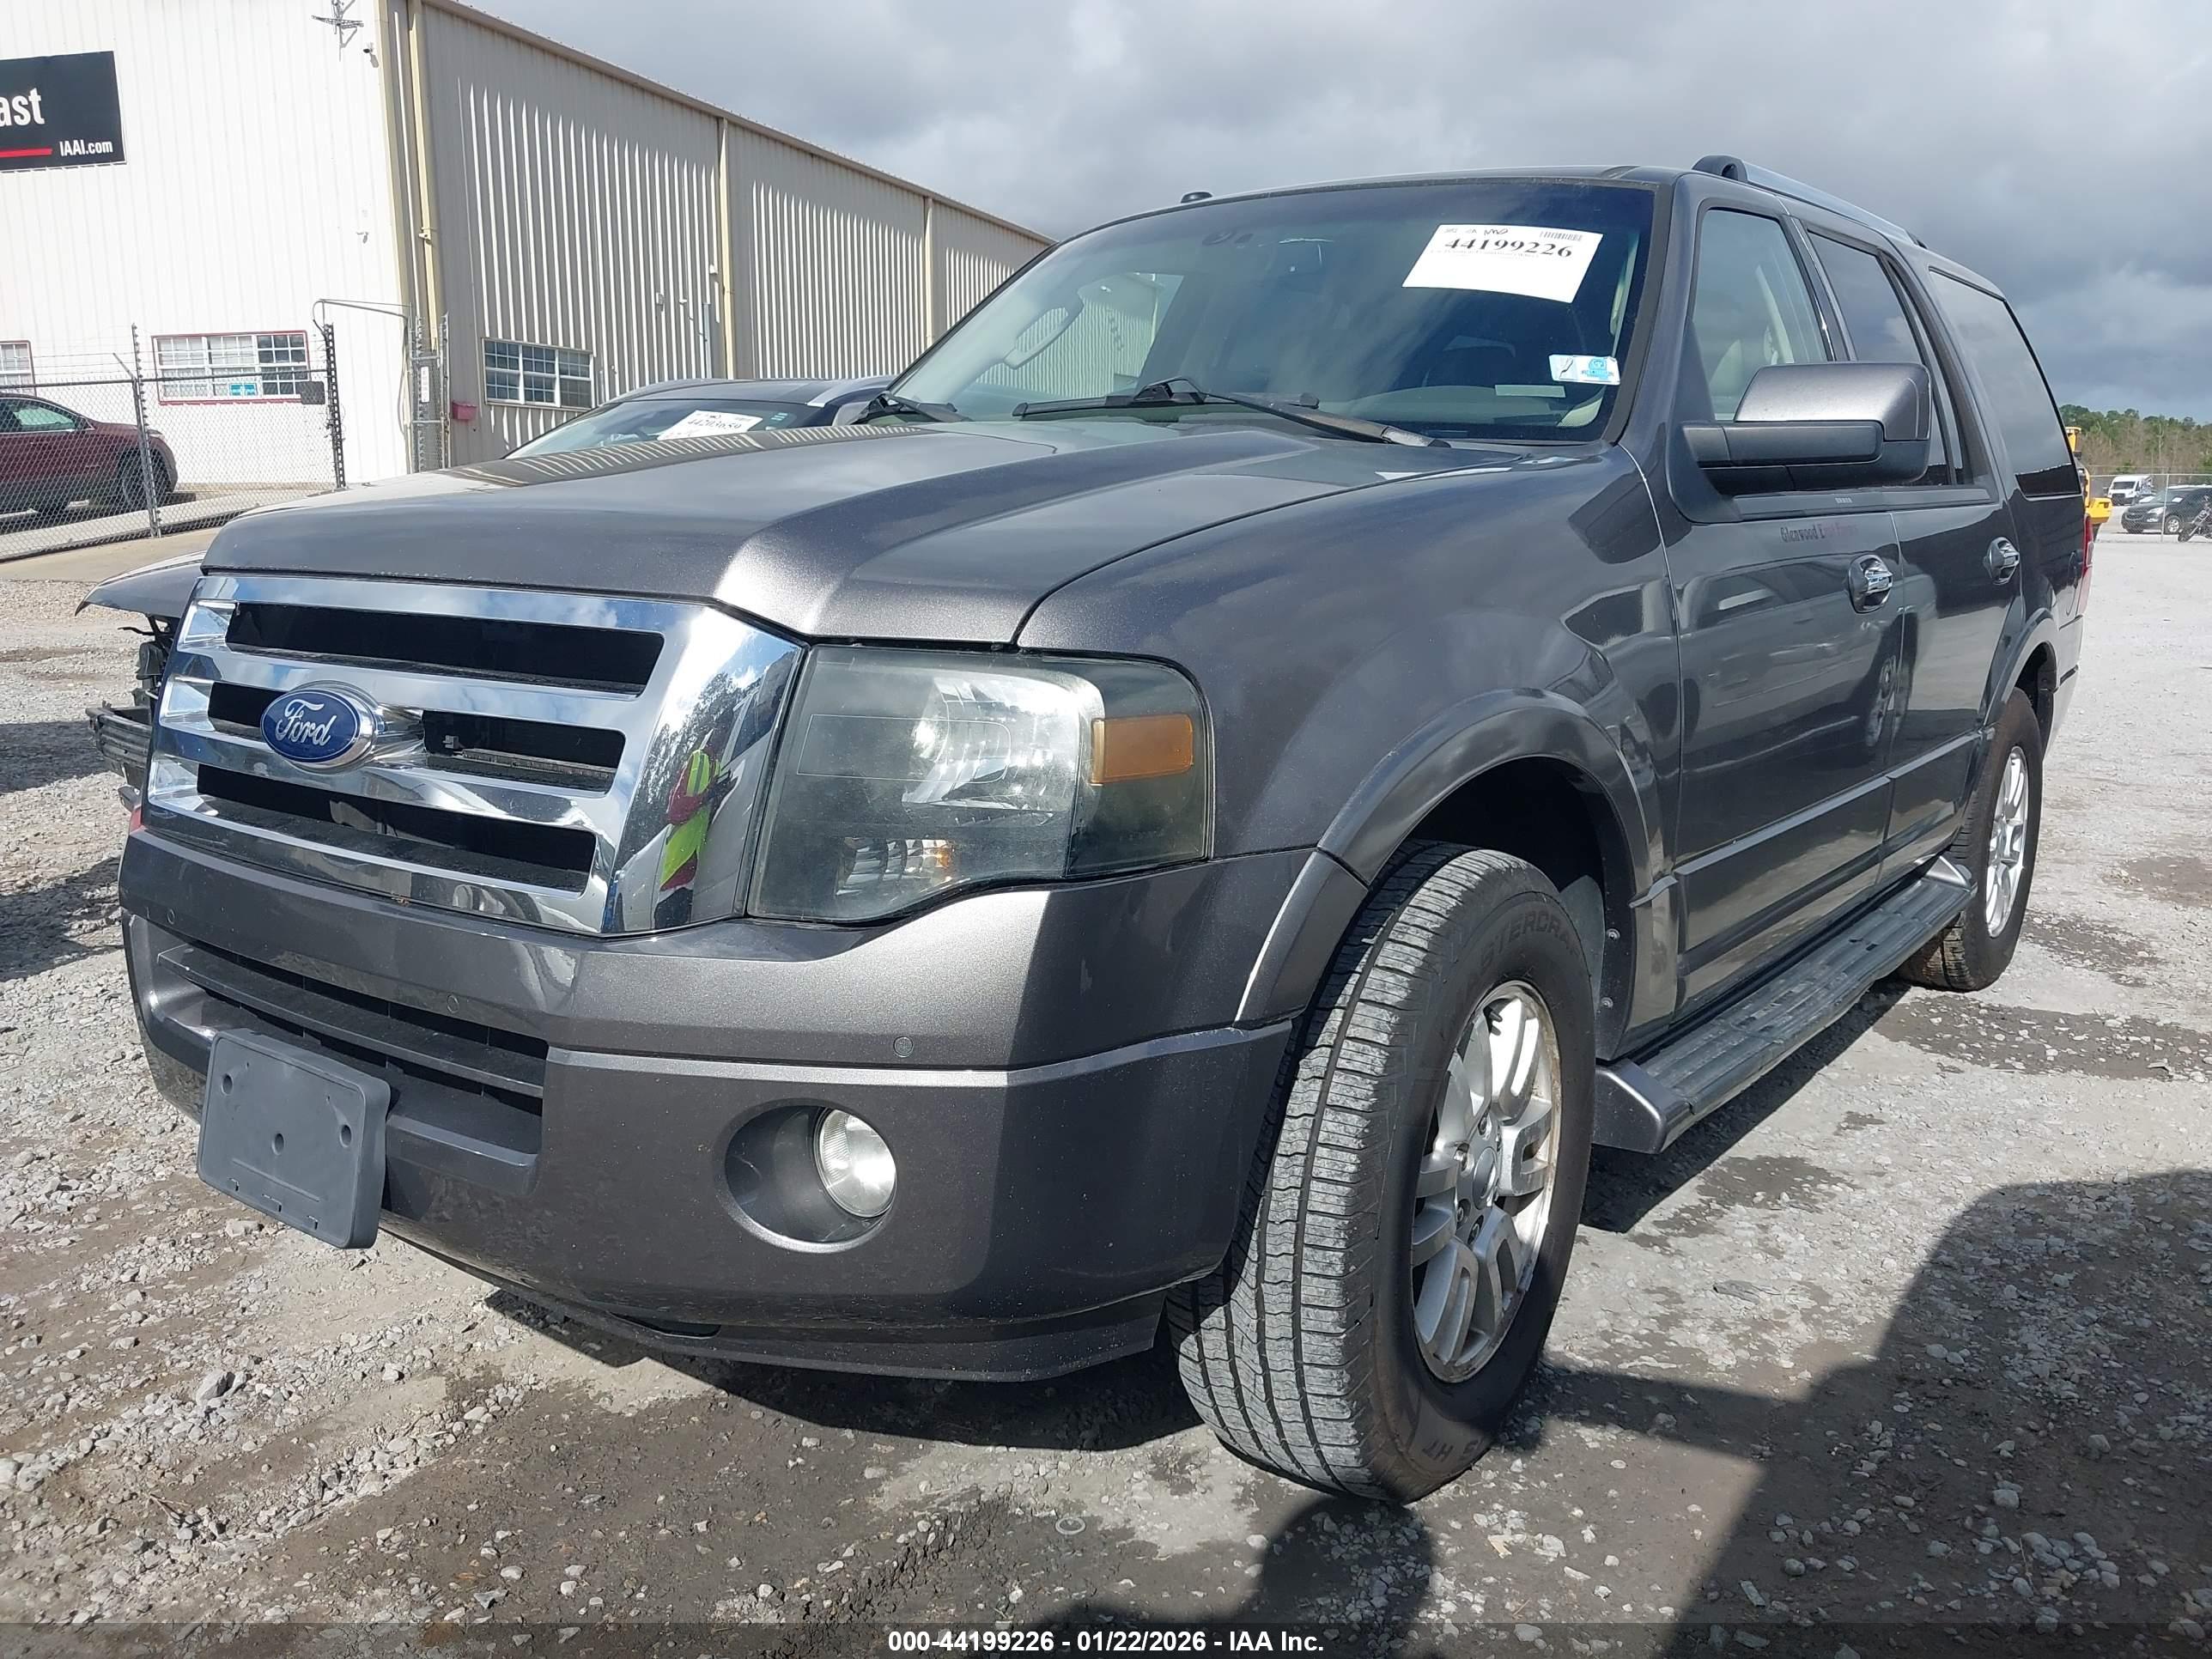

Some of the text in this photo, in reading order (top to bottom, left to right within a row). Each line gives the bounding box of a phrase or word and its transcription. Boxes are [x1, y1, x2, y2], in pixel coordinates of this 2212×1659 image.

[59, 139, 113, 156] IAAI.com
[1444, 238, 1572, 258] 44199226
[275, 698, 337, 746] Ford
